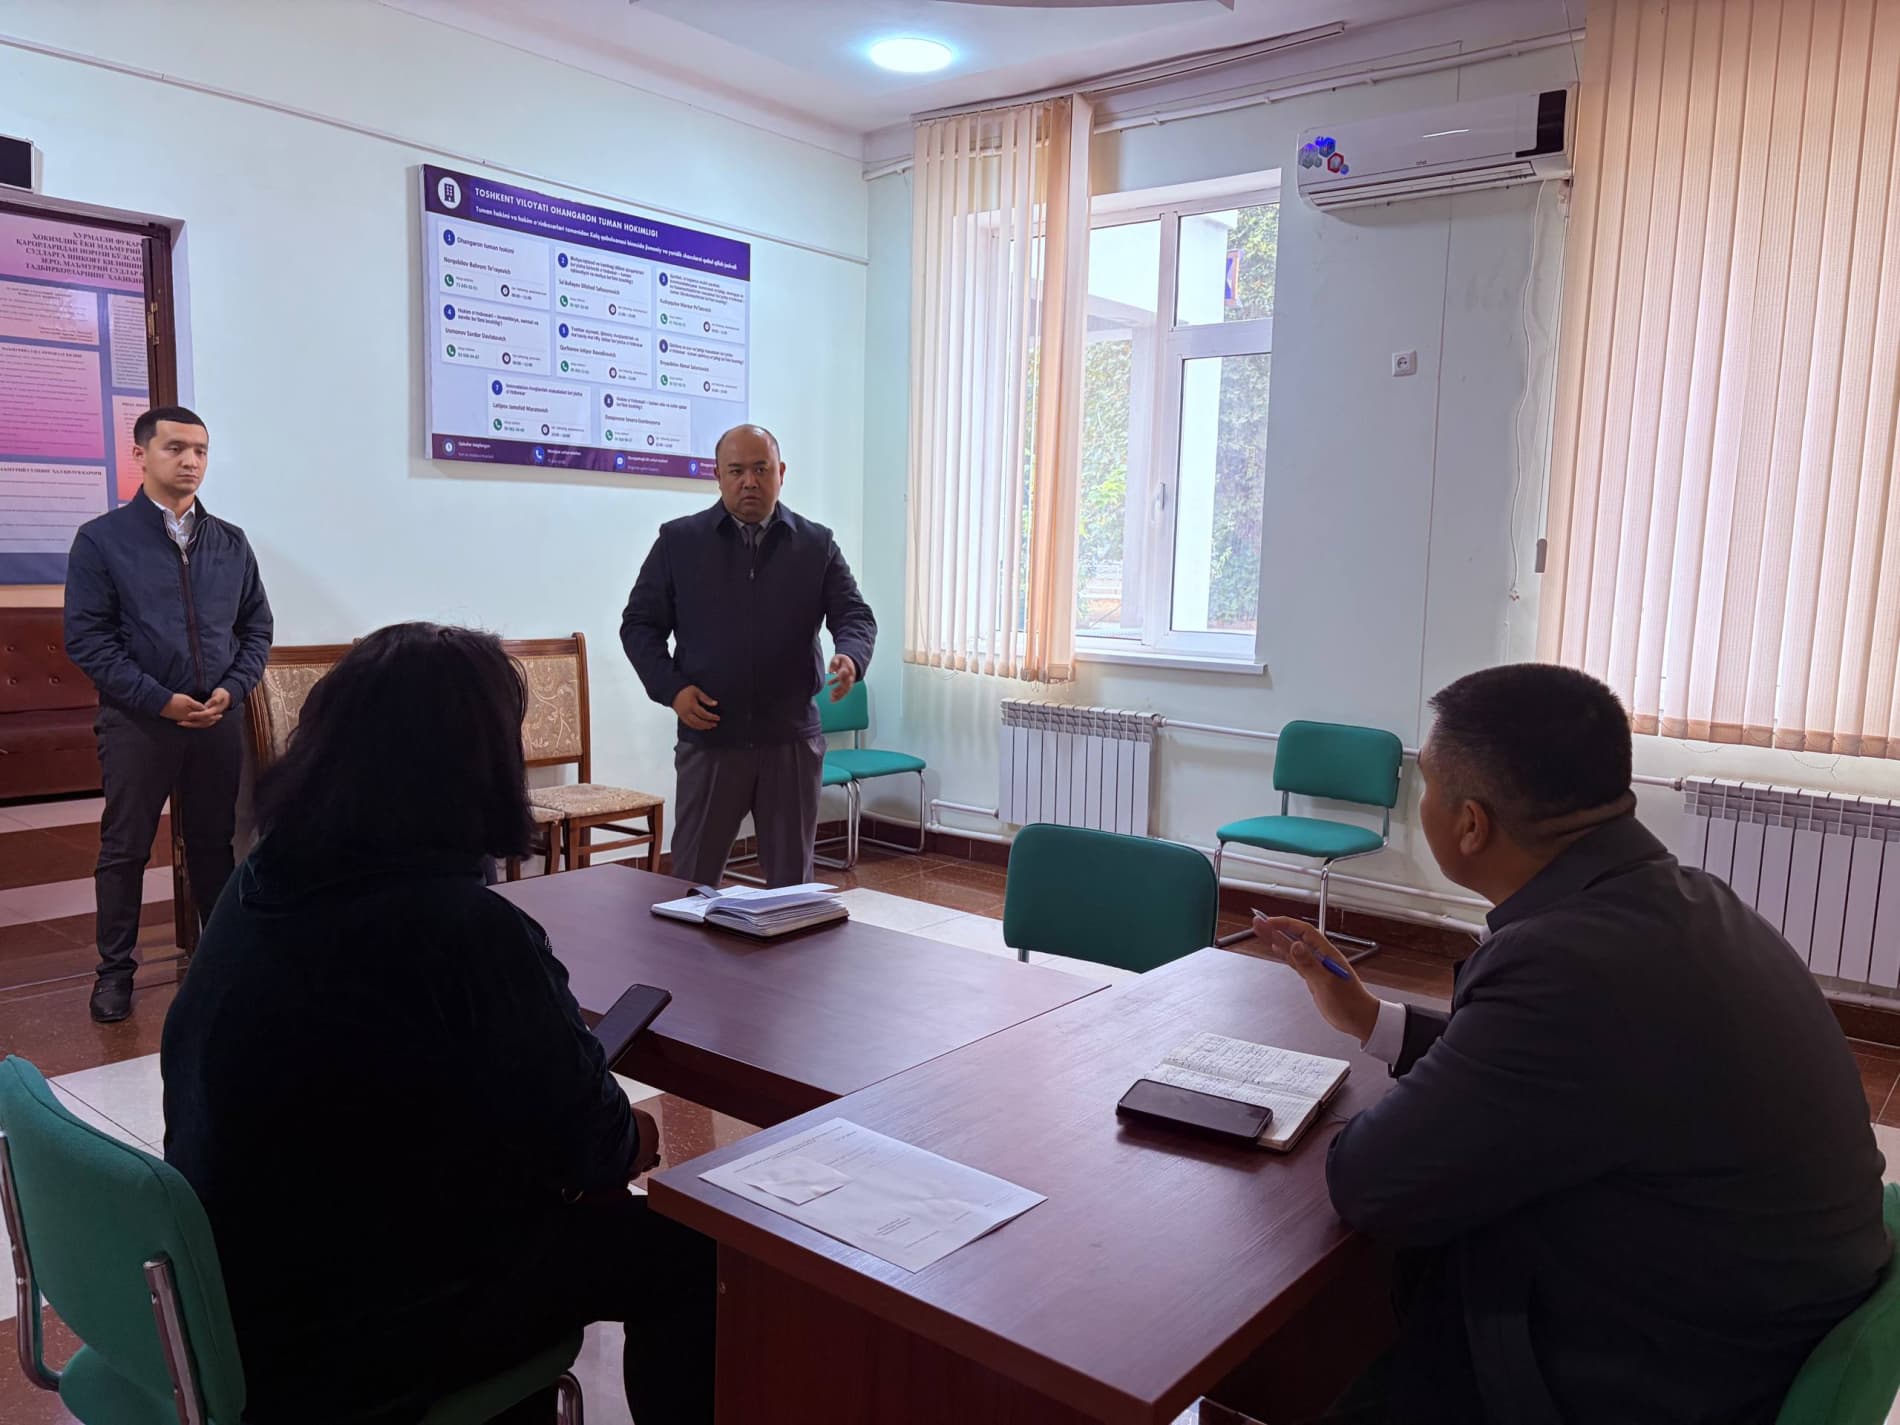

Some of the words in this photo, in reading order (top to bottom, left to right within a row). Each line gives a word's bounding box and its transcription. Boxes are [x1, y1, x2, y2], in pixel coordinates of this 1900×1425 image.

[475, 187, 514, 204] TOSHKENT
[516, 198, 549, 212] VILOYATI
[550, 206, 597, 224] OHANGARON
[598, 216, 622, 230] TUMAN
[624, 222, 658, 238] HOKIMLIGI
